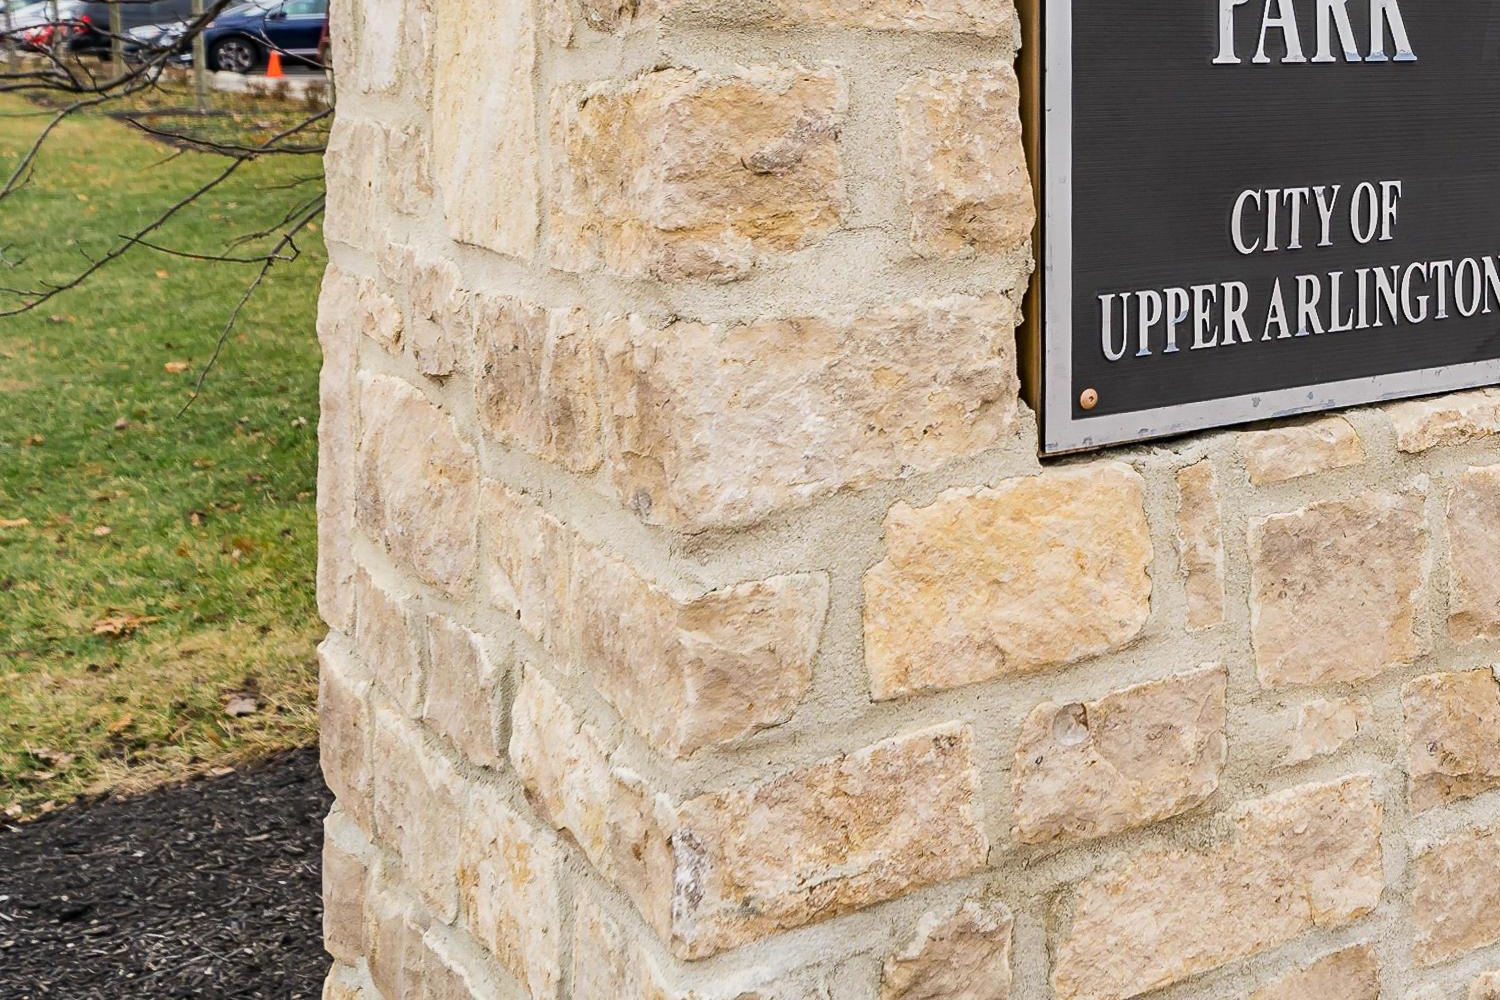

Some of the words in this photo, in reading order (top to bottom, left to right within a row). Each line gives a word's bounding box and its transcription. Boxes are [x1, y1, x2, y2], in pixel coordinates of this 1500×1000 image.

[1231, 184, 1342, 255] CITY
[1350, 180, 1402, 244] OF
[1097, 280, 1253, 361] UPPER
